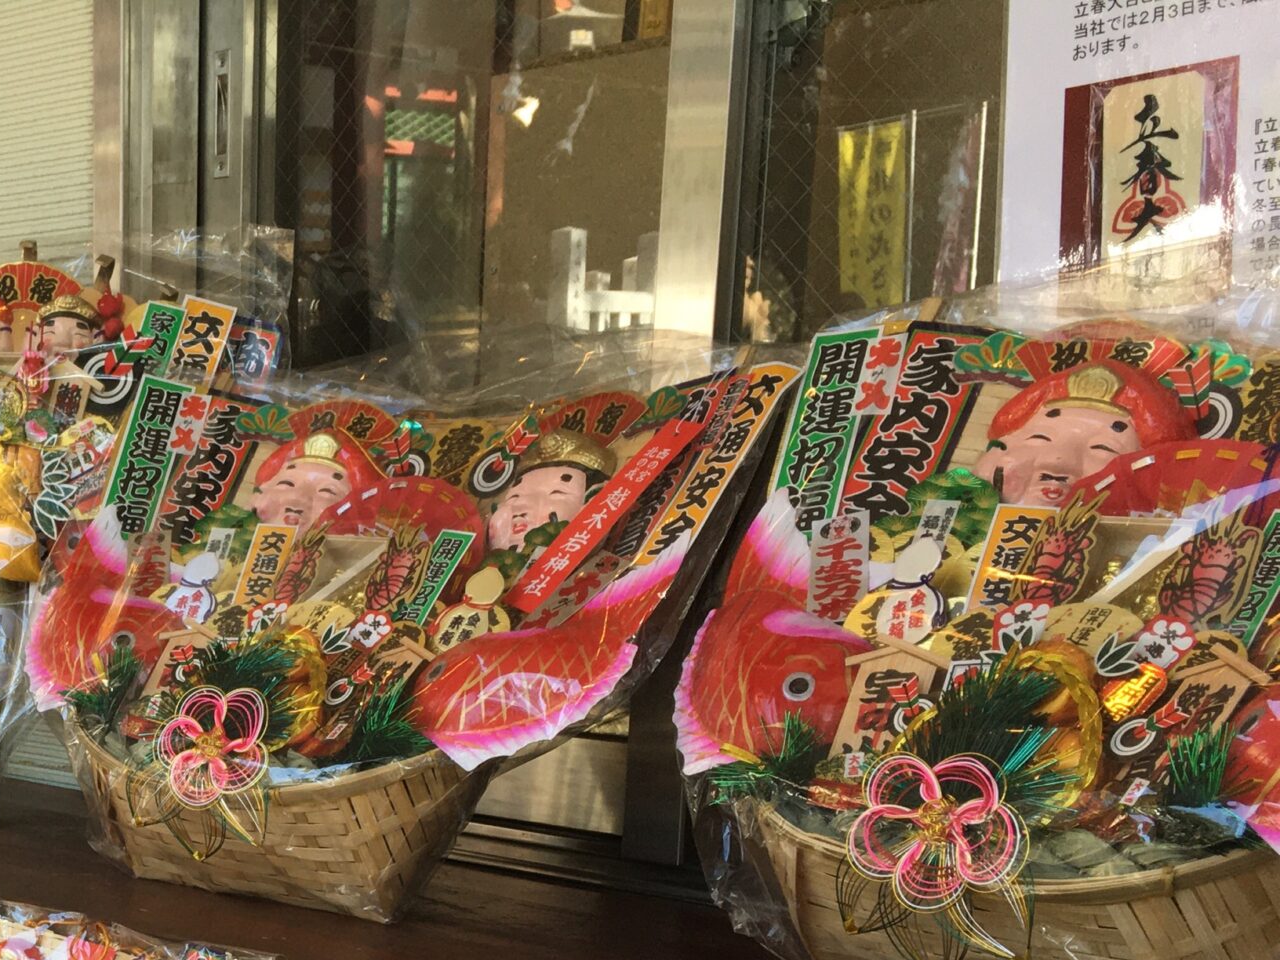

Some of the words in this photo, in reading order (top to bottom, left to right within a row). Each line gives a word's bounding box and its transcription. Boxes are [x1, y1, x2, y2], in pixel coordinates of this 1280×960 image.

[1072, 34, 1140, 61] おります。
[1119, 93, 1185, 285] 立春大
[116, 386, 183, 535] 開運招福
[158, 404, 250, 546] 家内安全
[646, 373, 783, 557] 交通安全
[786, 339, 869, 534] 開運招福
[842, 338, 962, 523] 家内安全
[522, 486, 631, 597] 越木岩神社
[1069, 606, 1112, 649] 開運
